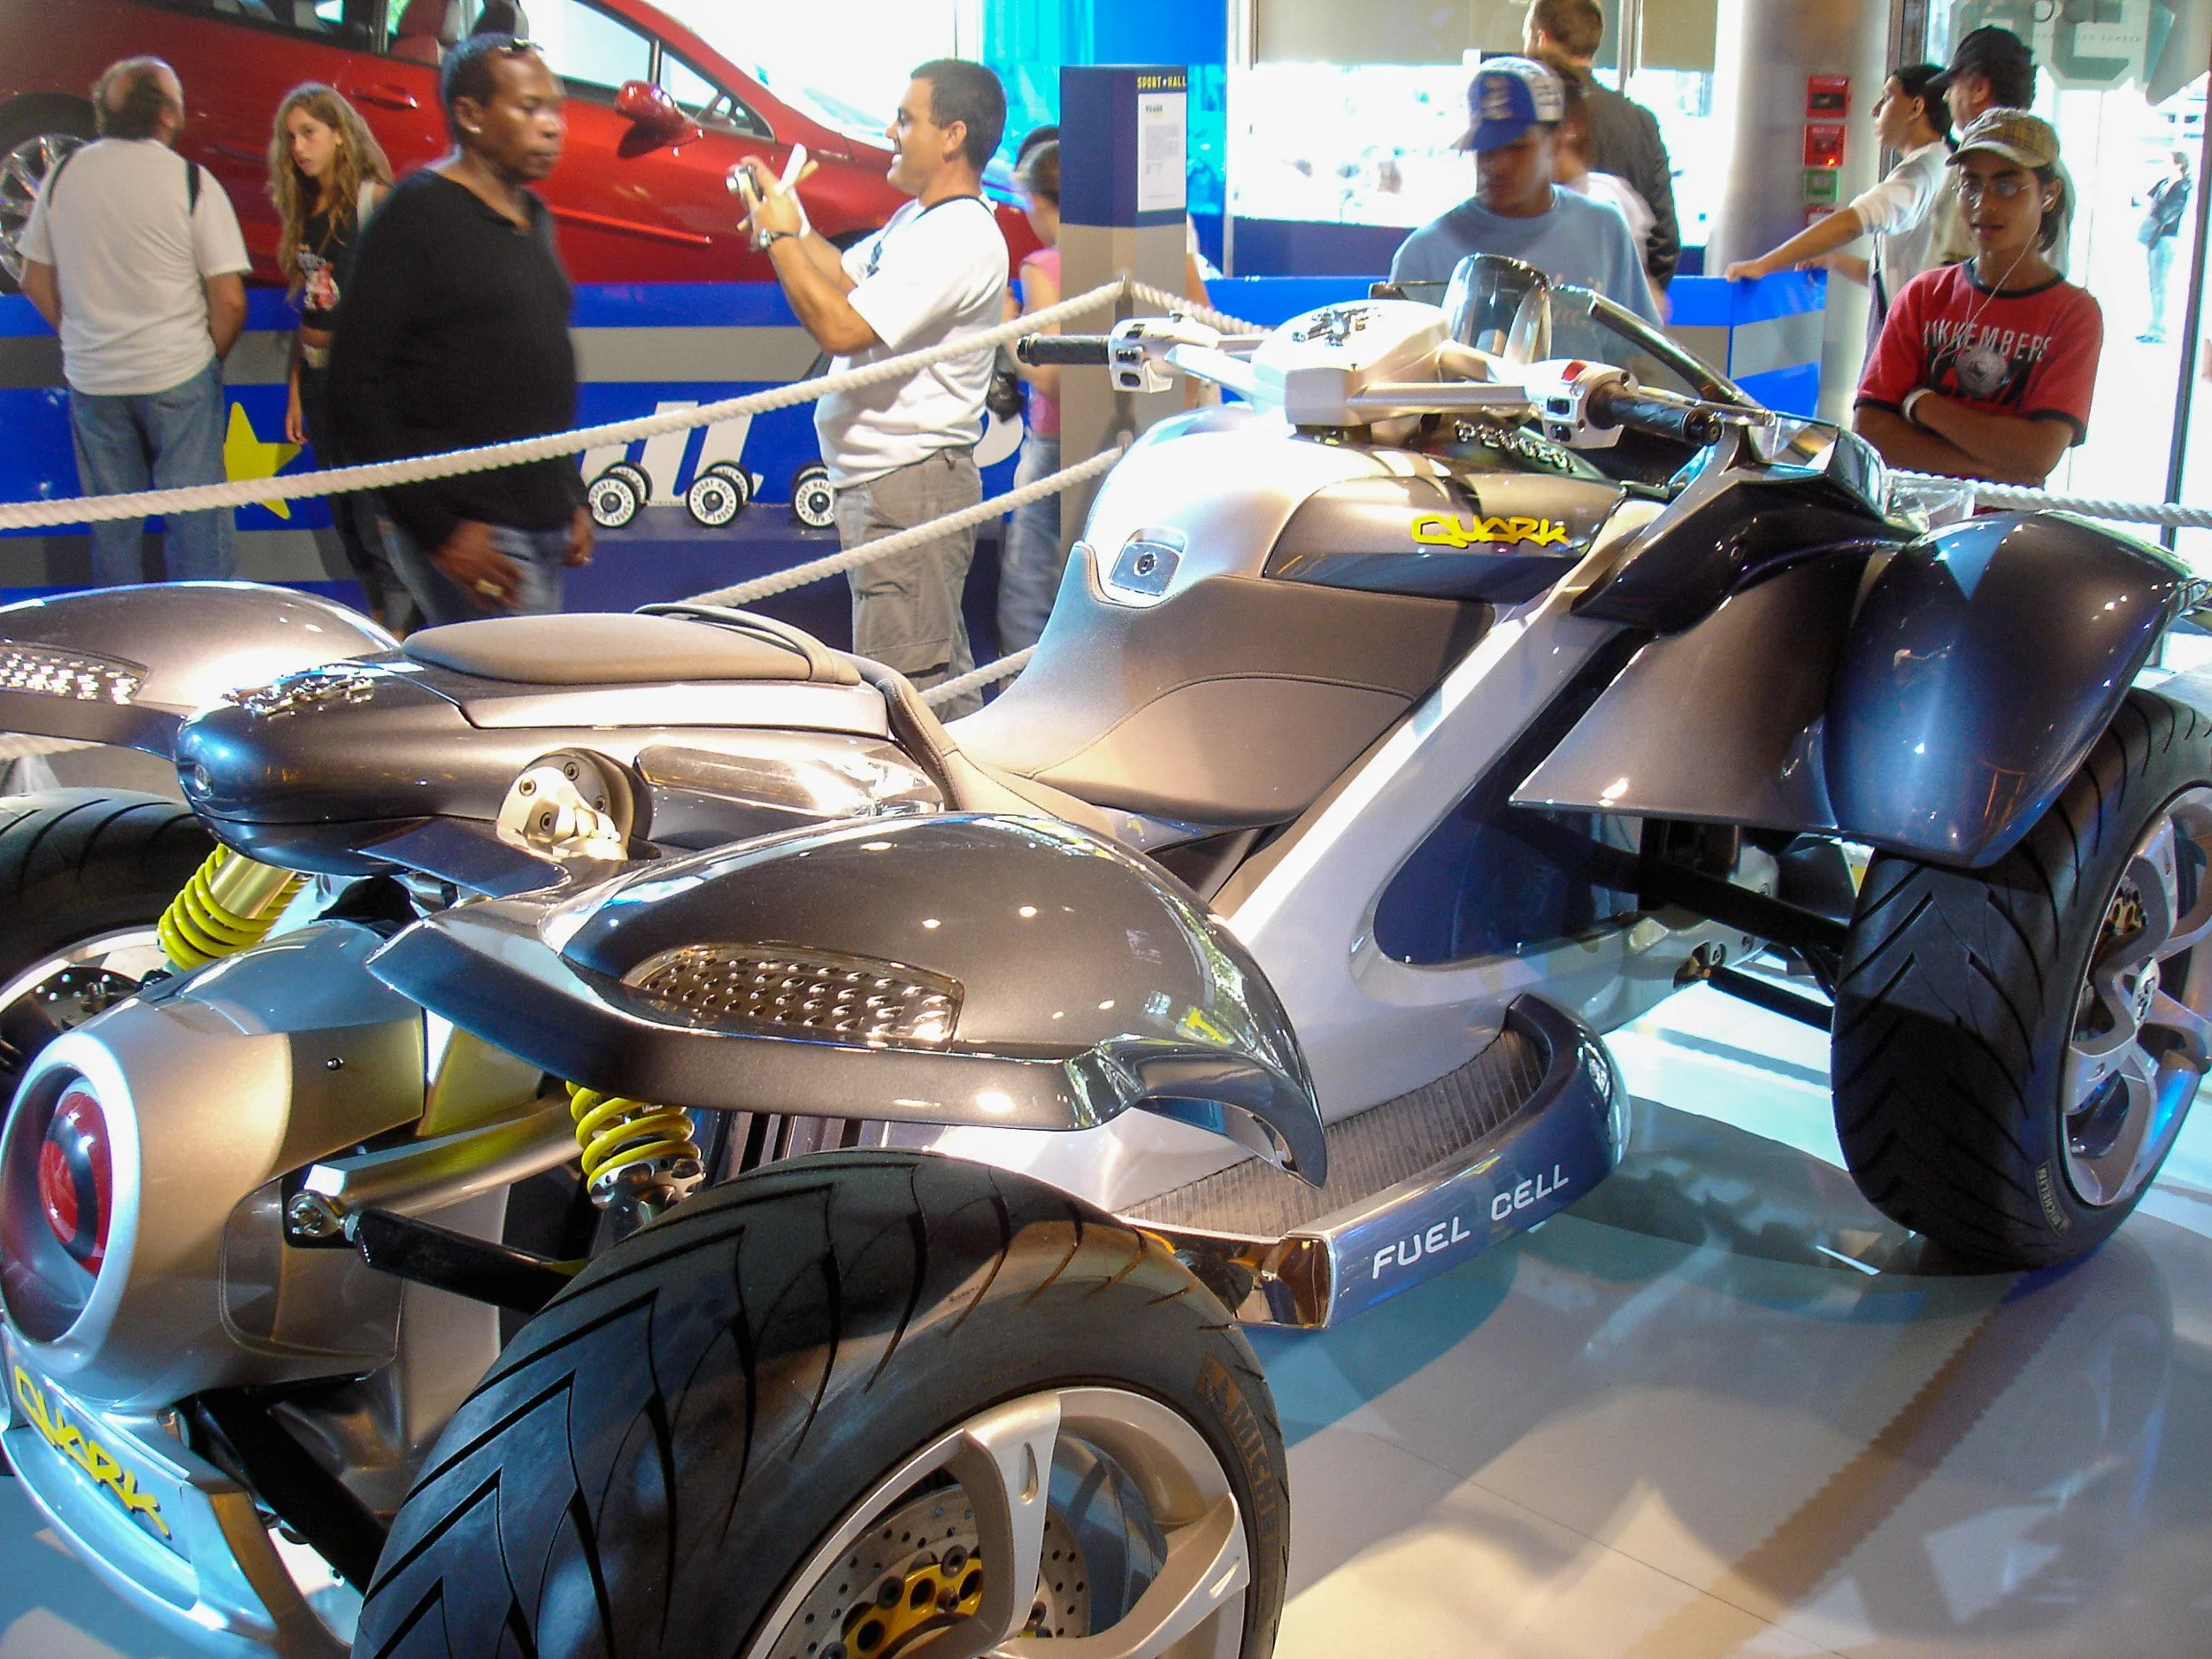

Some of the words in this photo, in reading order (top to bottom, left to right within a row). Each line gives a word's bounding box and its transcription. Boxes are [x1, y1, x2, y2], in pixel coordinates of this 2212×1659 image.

[1137, 76, 1162, 88] SPORT
[1167, 76, 1187, 88] HALL
[1412, 514, 1573, 549] QUARK
[1372, 1216, 1471, 1279] FUEL
[1490, 1164, 1570, 1221] CELL
[14, 1365, 172, 1538] QUARK
